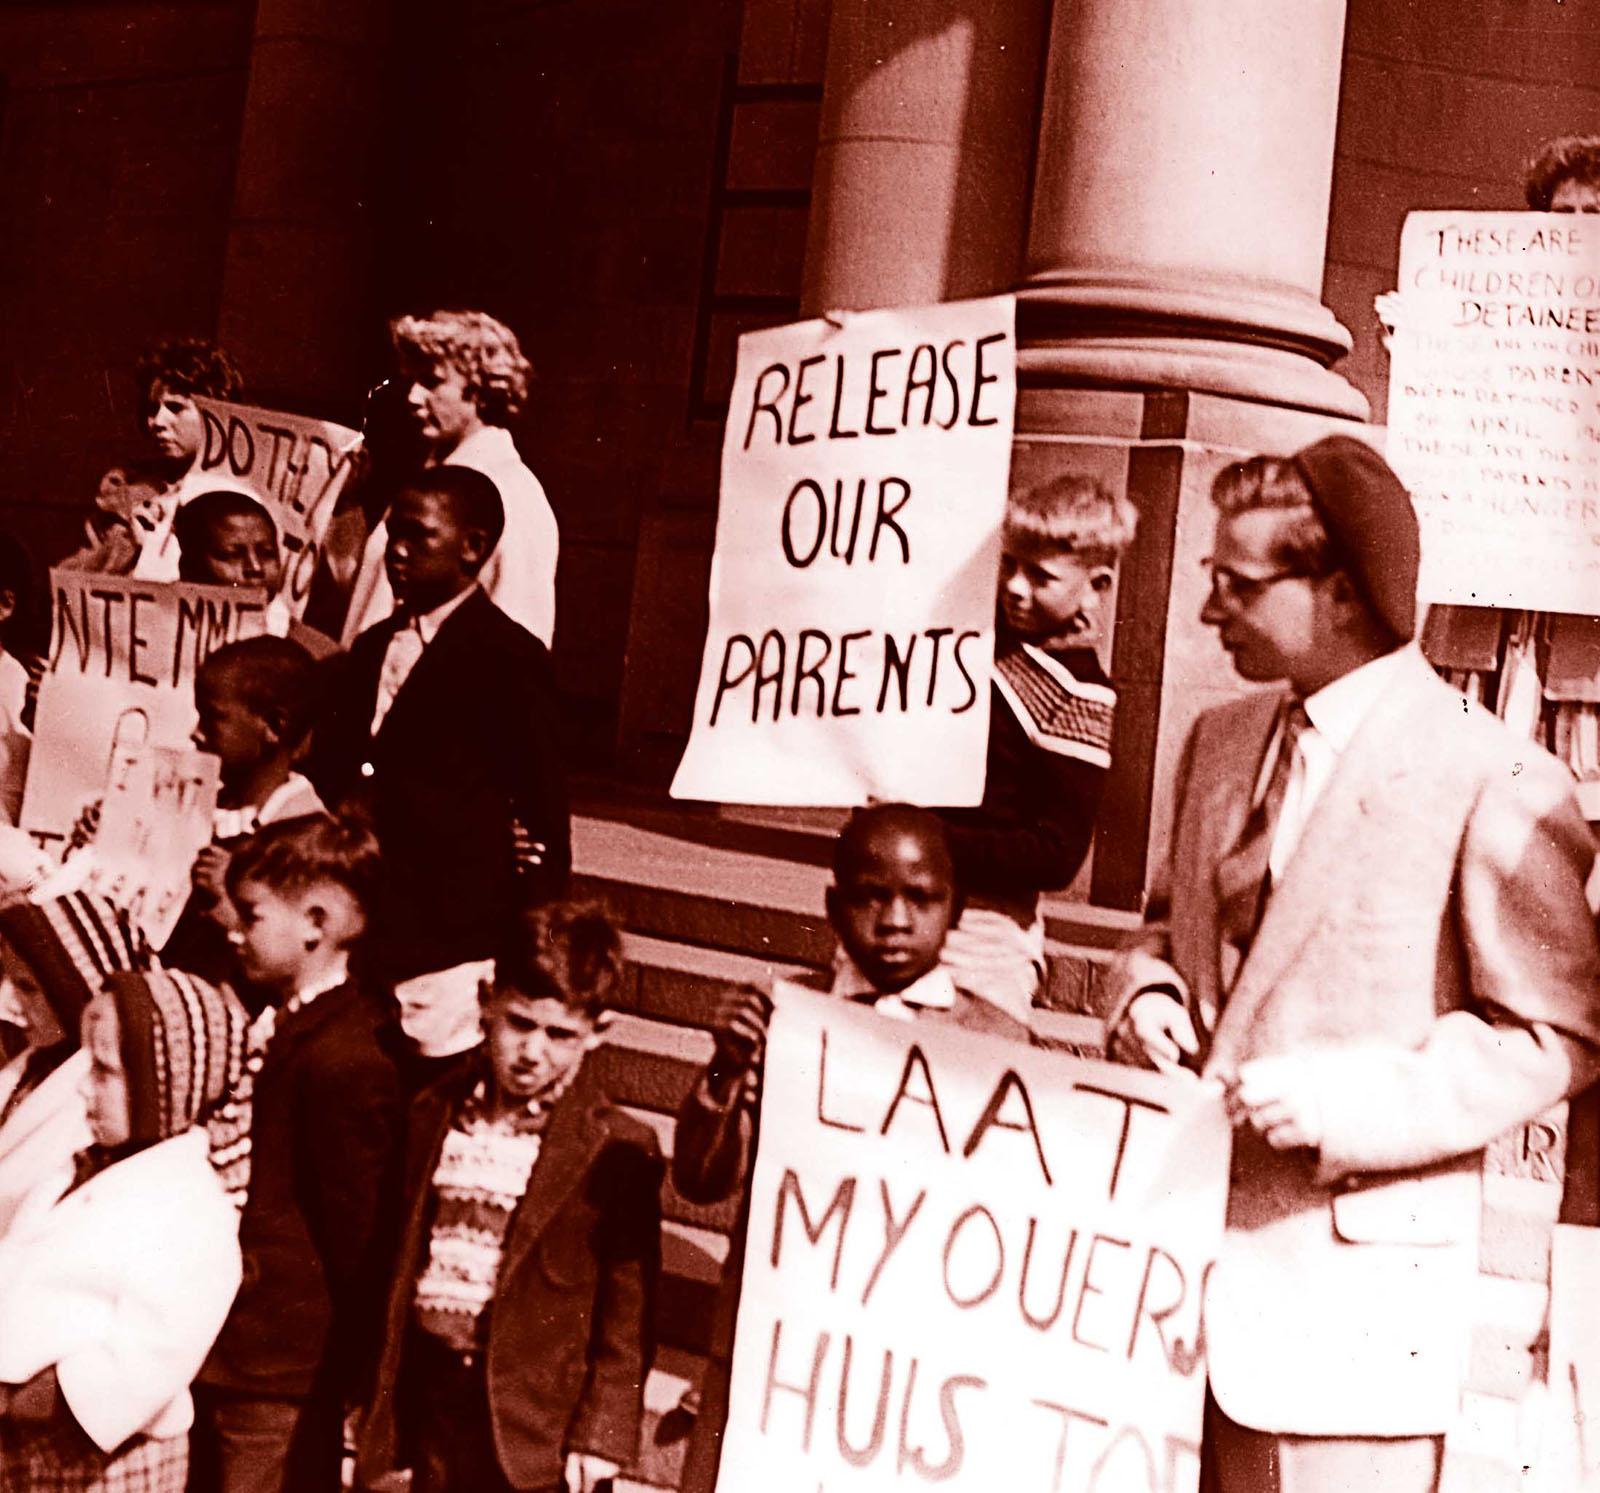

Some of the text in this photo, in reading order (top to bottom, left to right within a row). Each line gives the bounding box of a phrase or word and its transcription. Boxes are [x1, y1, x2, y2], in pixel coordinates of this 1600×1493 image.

[1413, 265, 1600, 299] CHILDREN O
[1426, 224, 1583, 257] THESE ARE
[743, 332, 1006, 450] RELEASE
[1507, 364, 1600, 387] PAREN
[201, 409, 255, 476] DO
[781, 476, 911, 568] OUR
[710, 628, 981, 727] PARENTS
[817, 1027, 1169, 1201] LAAT
[770, 1168, 926, 1306] MY
[759, 1320, 988, 1481] HUIS
